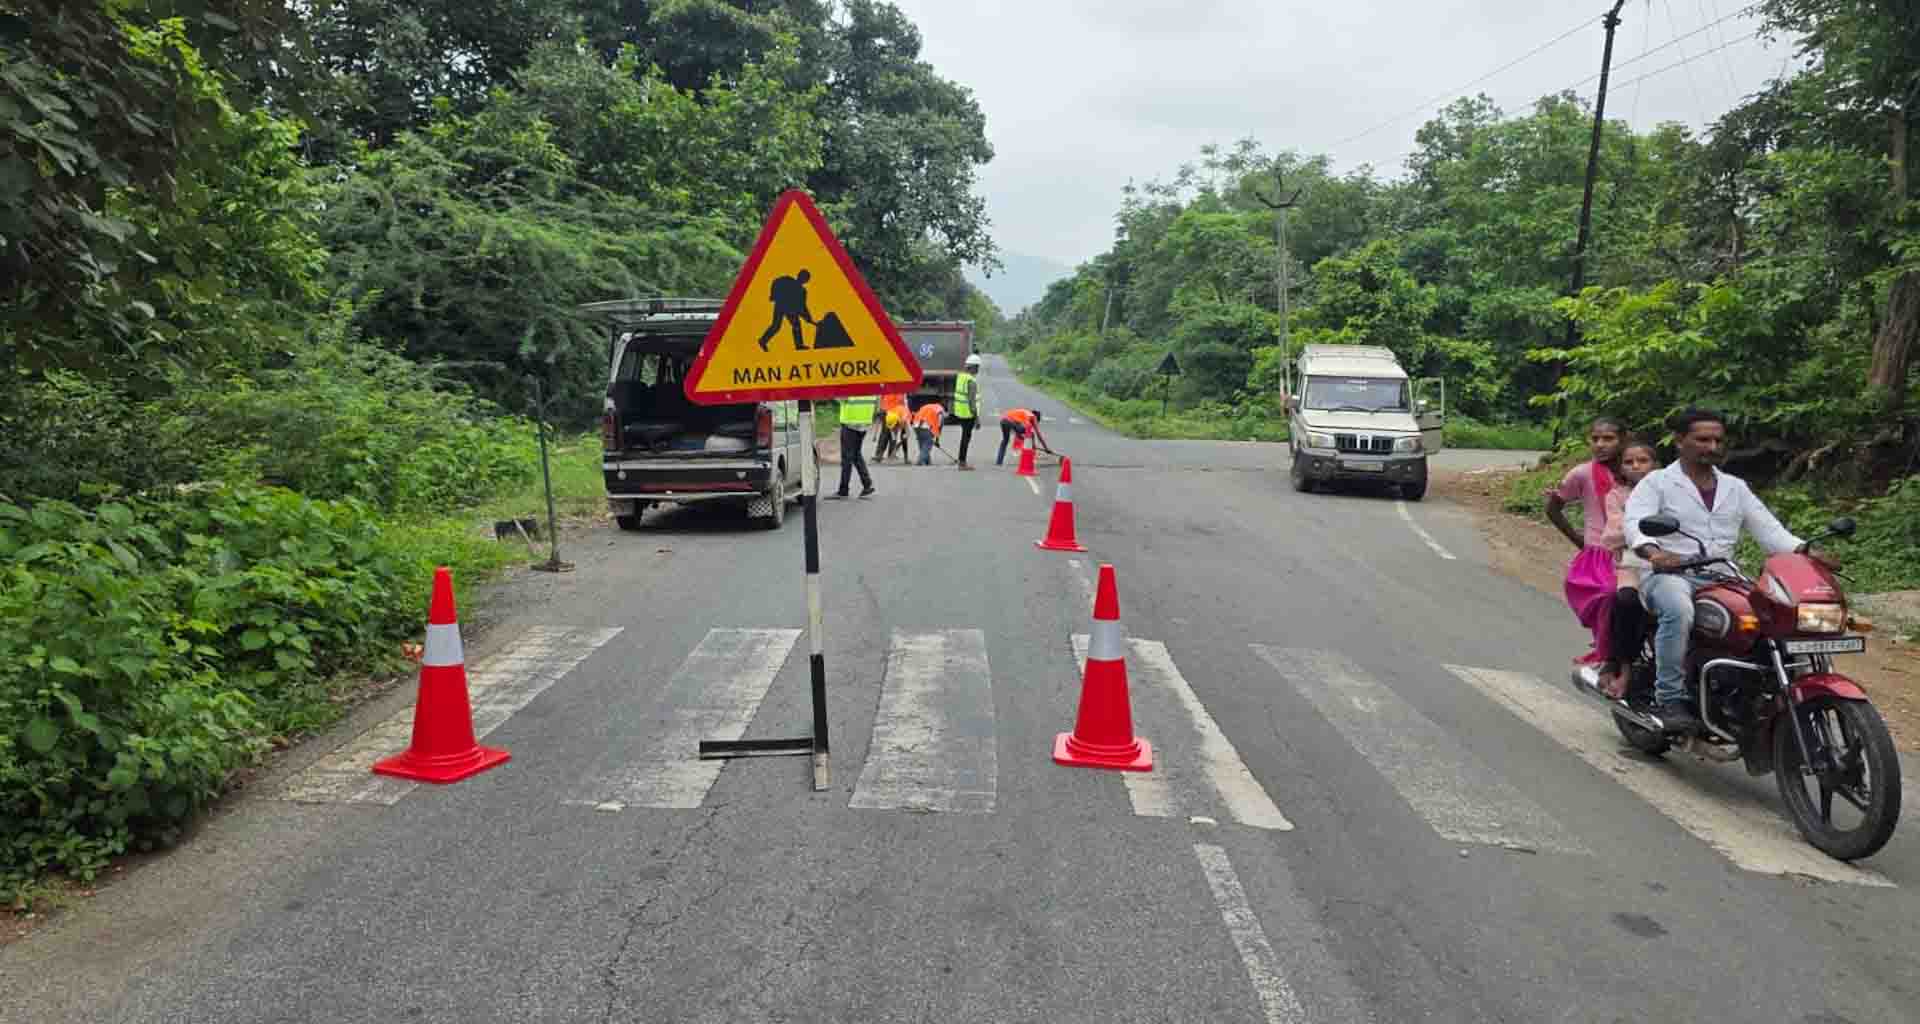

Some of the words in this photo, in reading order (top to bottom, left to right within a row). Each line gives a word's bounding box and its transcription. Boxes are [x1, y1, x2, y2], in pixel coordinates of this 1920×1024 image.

[733, 366, 782, 385] MAN
[789, 363, 813, 381] AT
[820, 359, 880, 379] WORK
